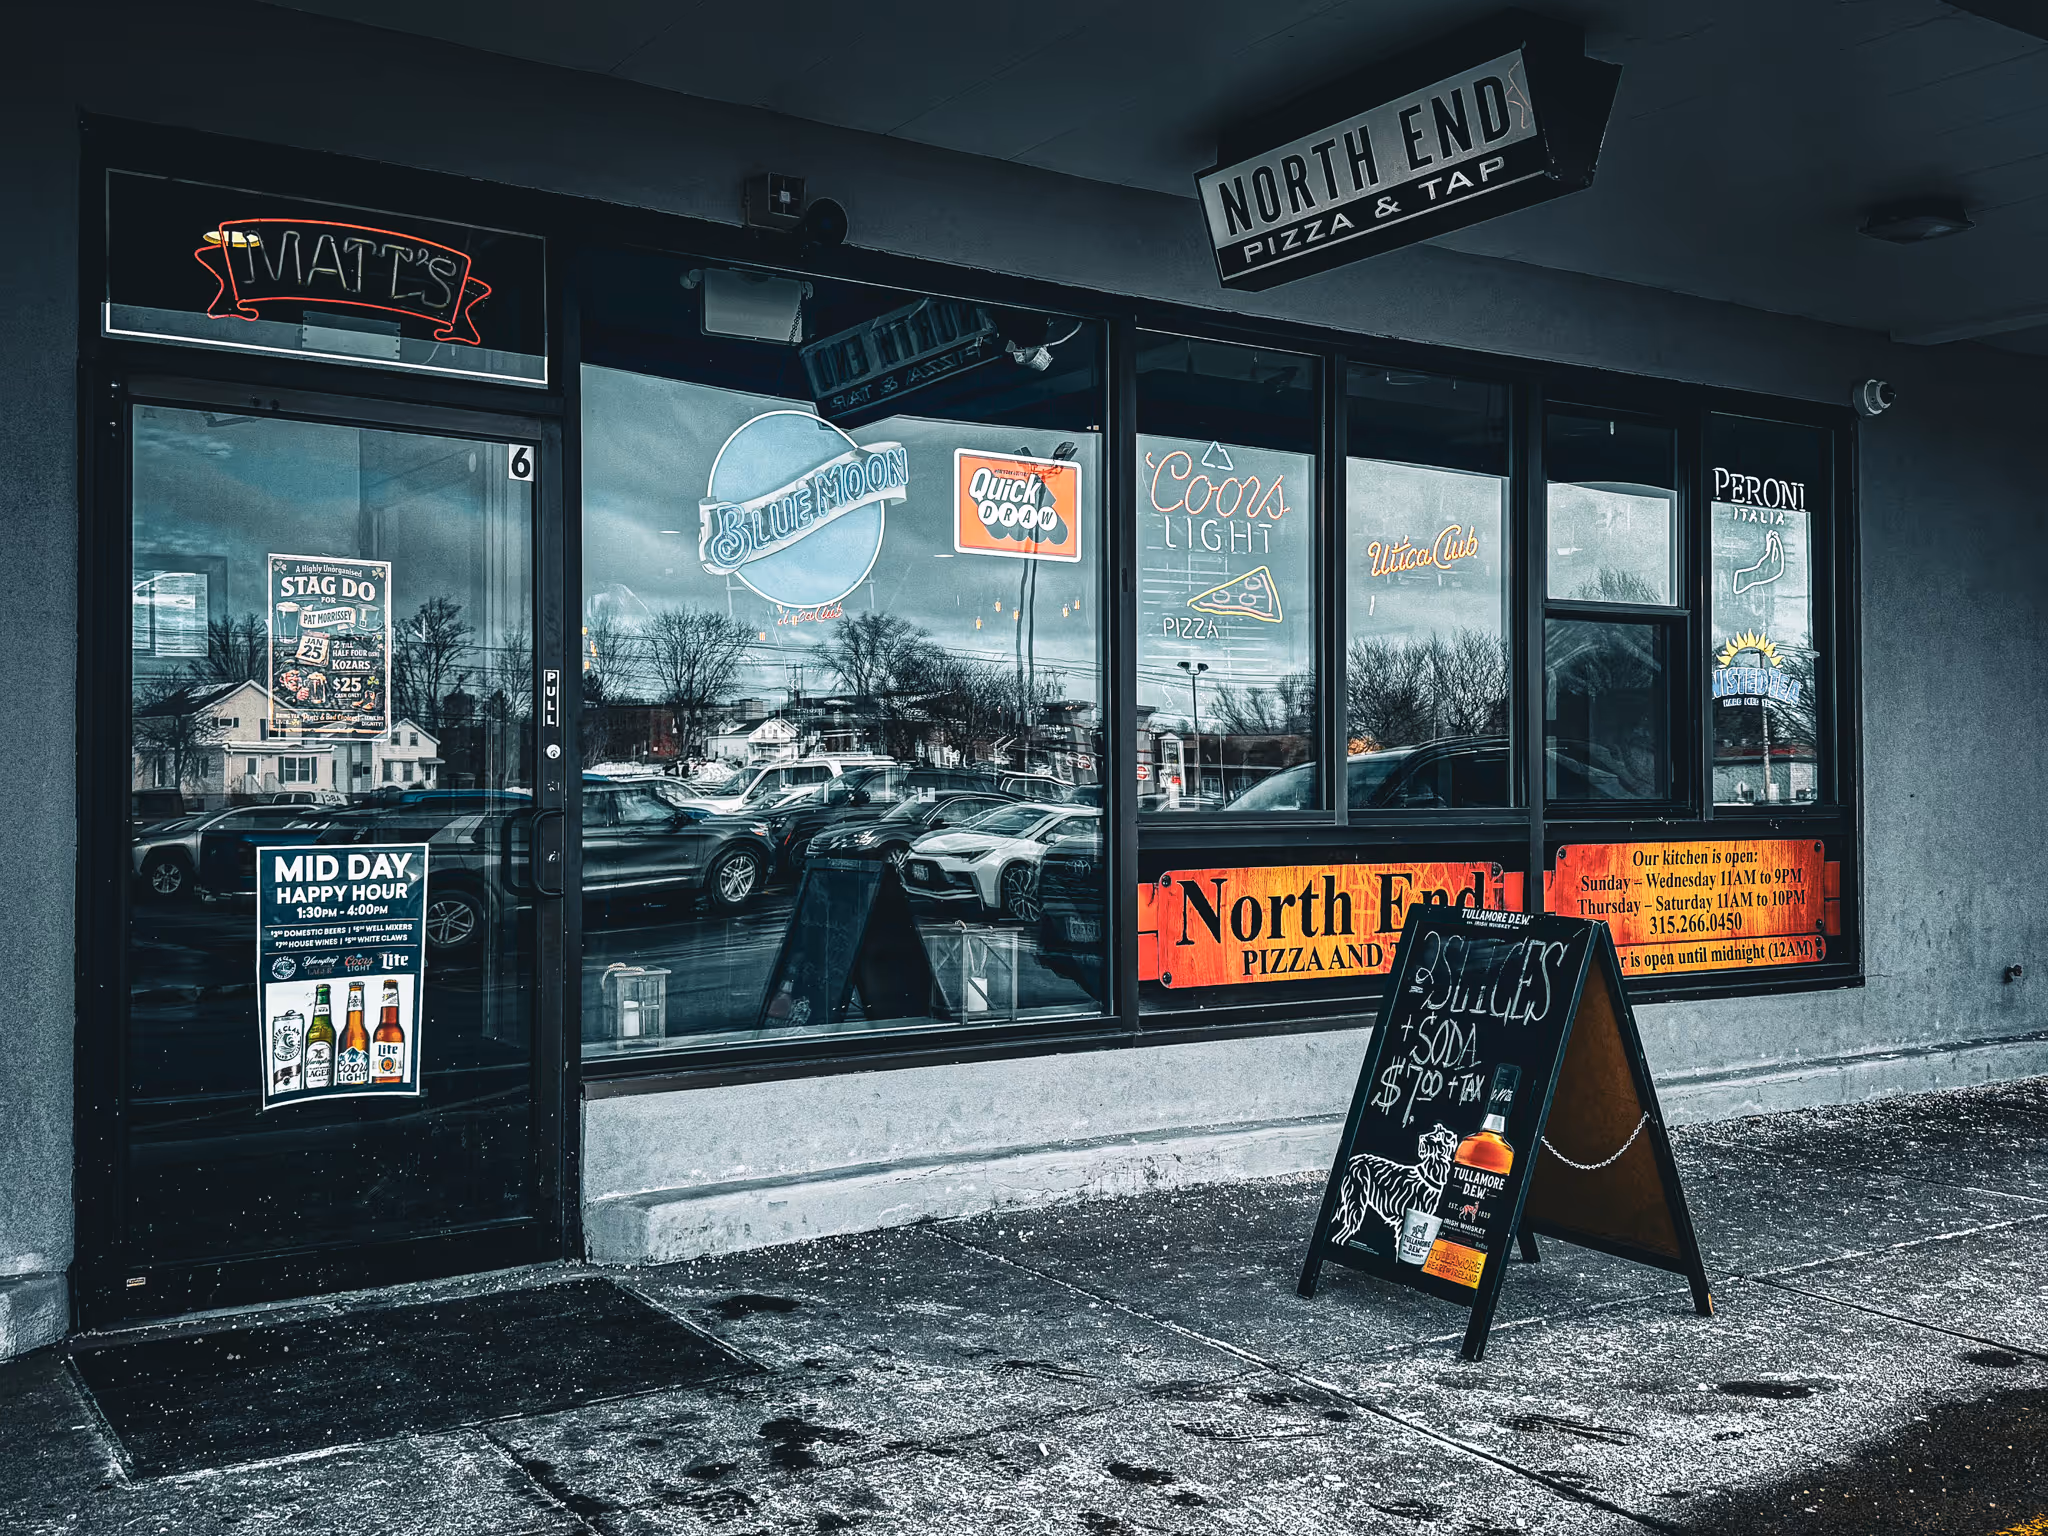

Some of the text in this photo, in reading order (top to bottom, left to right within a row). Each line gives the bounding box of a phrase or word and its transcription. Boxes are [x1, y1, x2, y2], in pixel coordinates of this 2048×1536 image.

[1218, 75, 1511, 237] NORTH END
[1243, 156, 1505, 263] PIZZA & TAP
[243, 230, 456, 308] MATT'S
[511, 447, 531, 479] 6
[968, 467, 1041, 504] Quick
[1145, 450, 1291, 520] Coors
[1712, 467, 1806, 512] PERONI
[710, 446, 909, 568] BLUE MOON
[981, 503, 1055, 528] DRAW
[1734, 507, 1785, 525] ITALIA
[1165, 515, 1273, 553] LIGHT
[1368, 524, 1478, 577] Utica Club
[296, 564, 362, 577] A Highly Unorganised
[281, 576, 376, 601] STAG DO
[303, 610, 352, 625] PAT MORRISSEY
[1163, 617, 1220, 640] PIZZA
[301, 645, 321, 660] 25
[304, 637, 323, 646] JAN
[332, 659, 370, 670] KOZARS
[333, 677, 362, 692] $25
[1712, 667, 1801, 706] WISTED TEA
[546, 672, 556, 725] PULL
[275, 853, 413, 883] MID DAY
[1632, 848, 1758, 867] Our kitchen is open:
[1581, 875, 1631, 894] Sunday
[1646, 871, 1716, 892] Wednesday
[1720, 869, 1757, 886] 11AM
[1759, 870, 1771, 884] to
[1774, 868, 1802, 884] 9PM
[277, 883, 408, 904] HAPPY HOUR
[1577, 898, 1641, 918] Thursday
[1655, 894, 1714, 914] Saturday
[1717, 892, 1754, 909] 11AM
[1756, 892, 1768, 907] to
[1772, 890, 1806, 906] 10PM
[297, 906, 337, 919] 1:30PM
[347, 904, 388, 917] 4:00PM
[1176, 874, 1353, 946] North
[1462, 908, 1530, 925] TULLAMORE D.E.W.
[284, 928, 323, 937] DOMESTIC
[324, 927, 346, 935] BEERS
[366, 924, 385, 932] WELL
[1650, 912, 1742, 935] 315.266.0450
[289, 940, 313, 948] HOUSE
[315, 938, 338, 947] WINES
[357, 935, 380, 943] WHITE
[381, 934, 408, 942] CLAWS
[345, 955, 374, 966] Coors
[381, 953, 409, 970] Lite
[1243, 945, 1330, 976] PIZZA
[1330, 941, 1383, 969] AND
[1415, 930, 1441, 984] 2
[1630, 953, 1640, 968] is
[1644, 954, 1675, 971] open
[1677, 946, 1708, 965] until
[1711, 943, 1765, 965] midnight
[1768, 939, 1814, 962] (12AM)
[377, 1044, 398, 1057] Lite
[1409, 1012, 1482, 1070] SODA
[338, 1072, 366, 1082] LIGHT
[1459, 1074, 1485, 1106] TAX
[1453, 1167, 1506, 1191] TULLAMORE
[1462, 1183, 1486, 1200] D.E.W.
[1448, 1202, 1459, 1210] EST.
[1443, 1218, 1460, 1228] IRISH
[1460, 1222, 1486, 1236] WHISKEY
[1404, 1234, 1431, 1248] TULLAMORE
